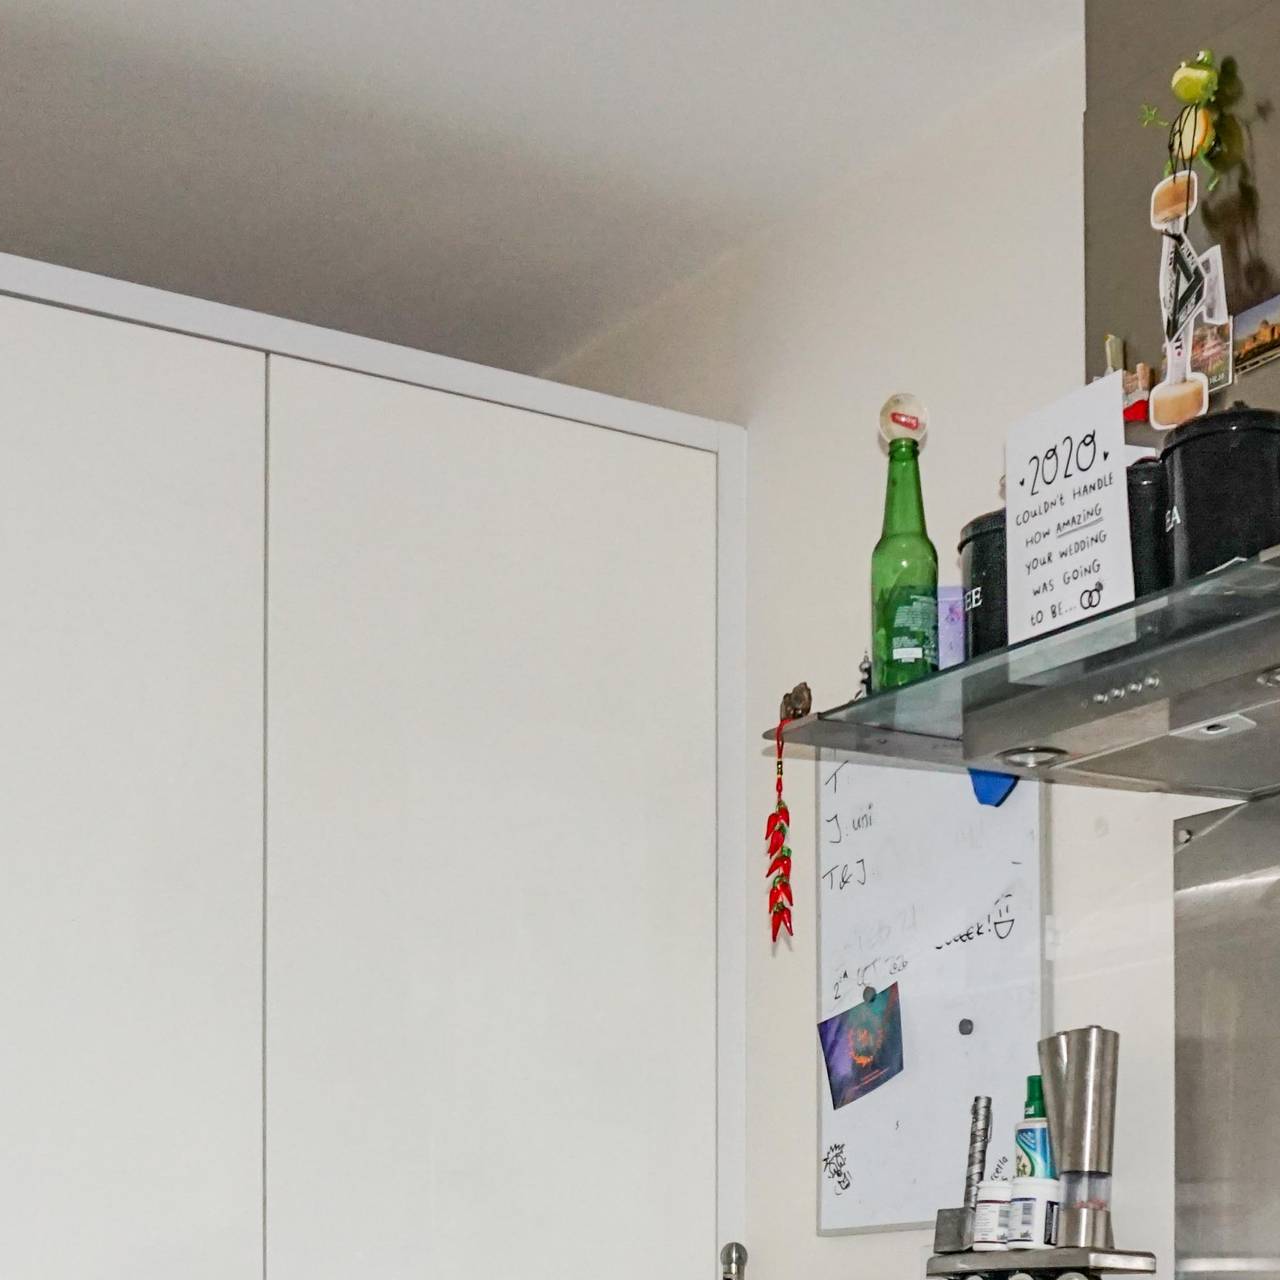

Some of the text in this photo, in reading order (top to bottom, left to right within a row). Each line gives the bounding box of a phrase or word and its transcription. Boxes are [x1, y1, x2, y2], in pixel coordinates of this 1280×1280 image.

[1028, 429, 1096, 497] 2020
[1073, 472, 1113, 500] HANDLE
[1026, 503, 1102, 548] HOW AMAZING
[1165, 505, 1181, 532] EA
[1025, 530, 1107, 576] YOUR WEDDING
[1033, 559, 1101, 597] WAS GOING
